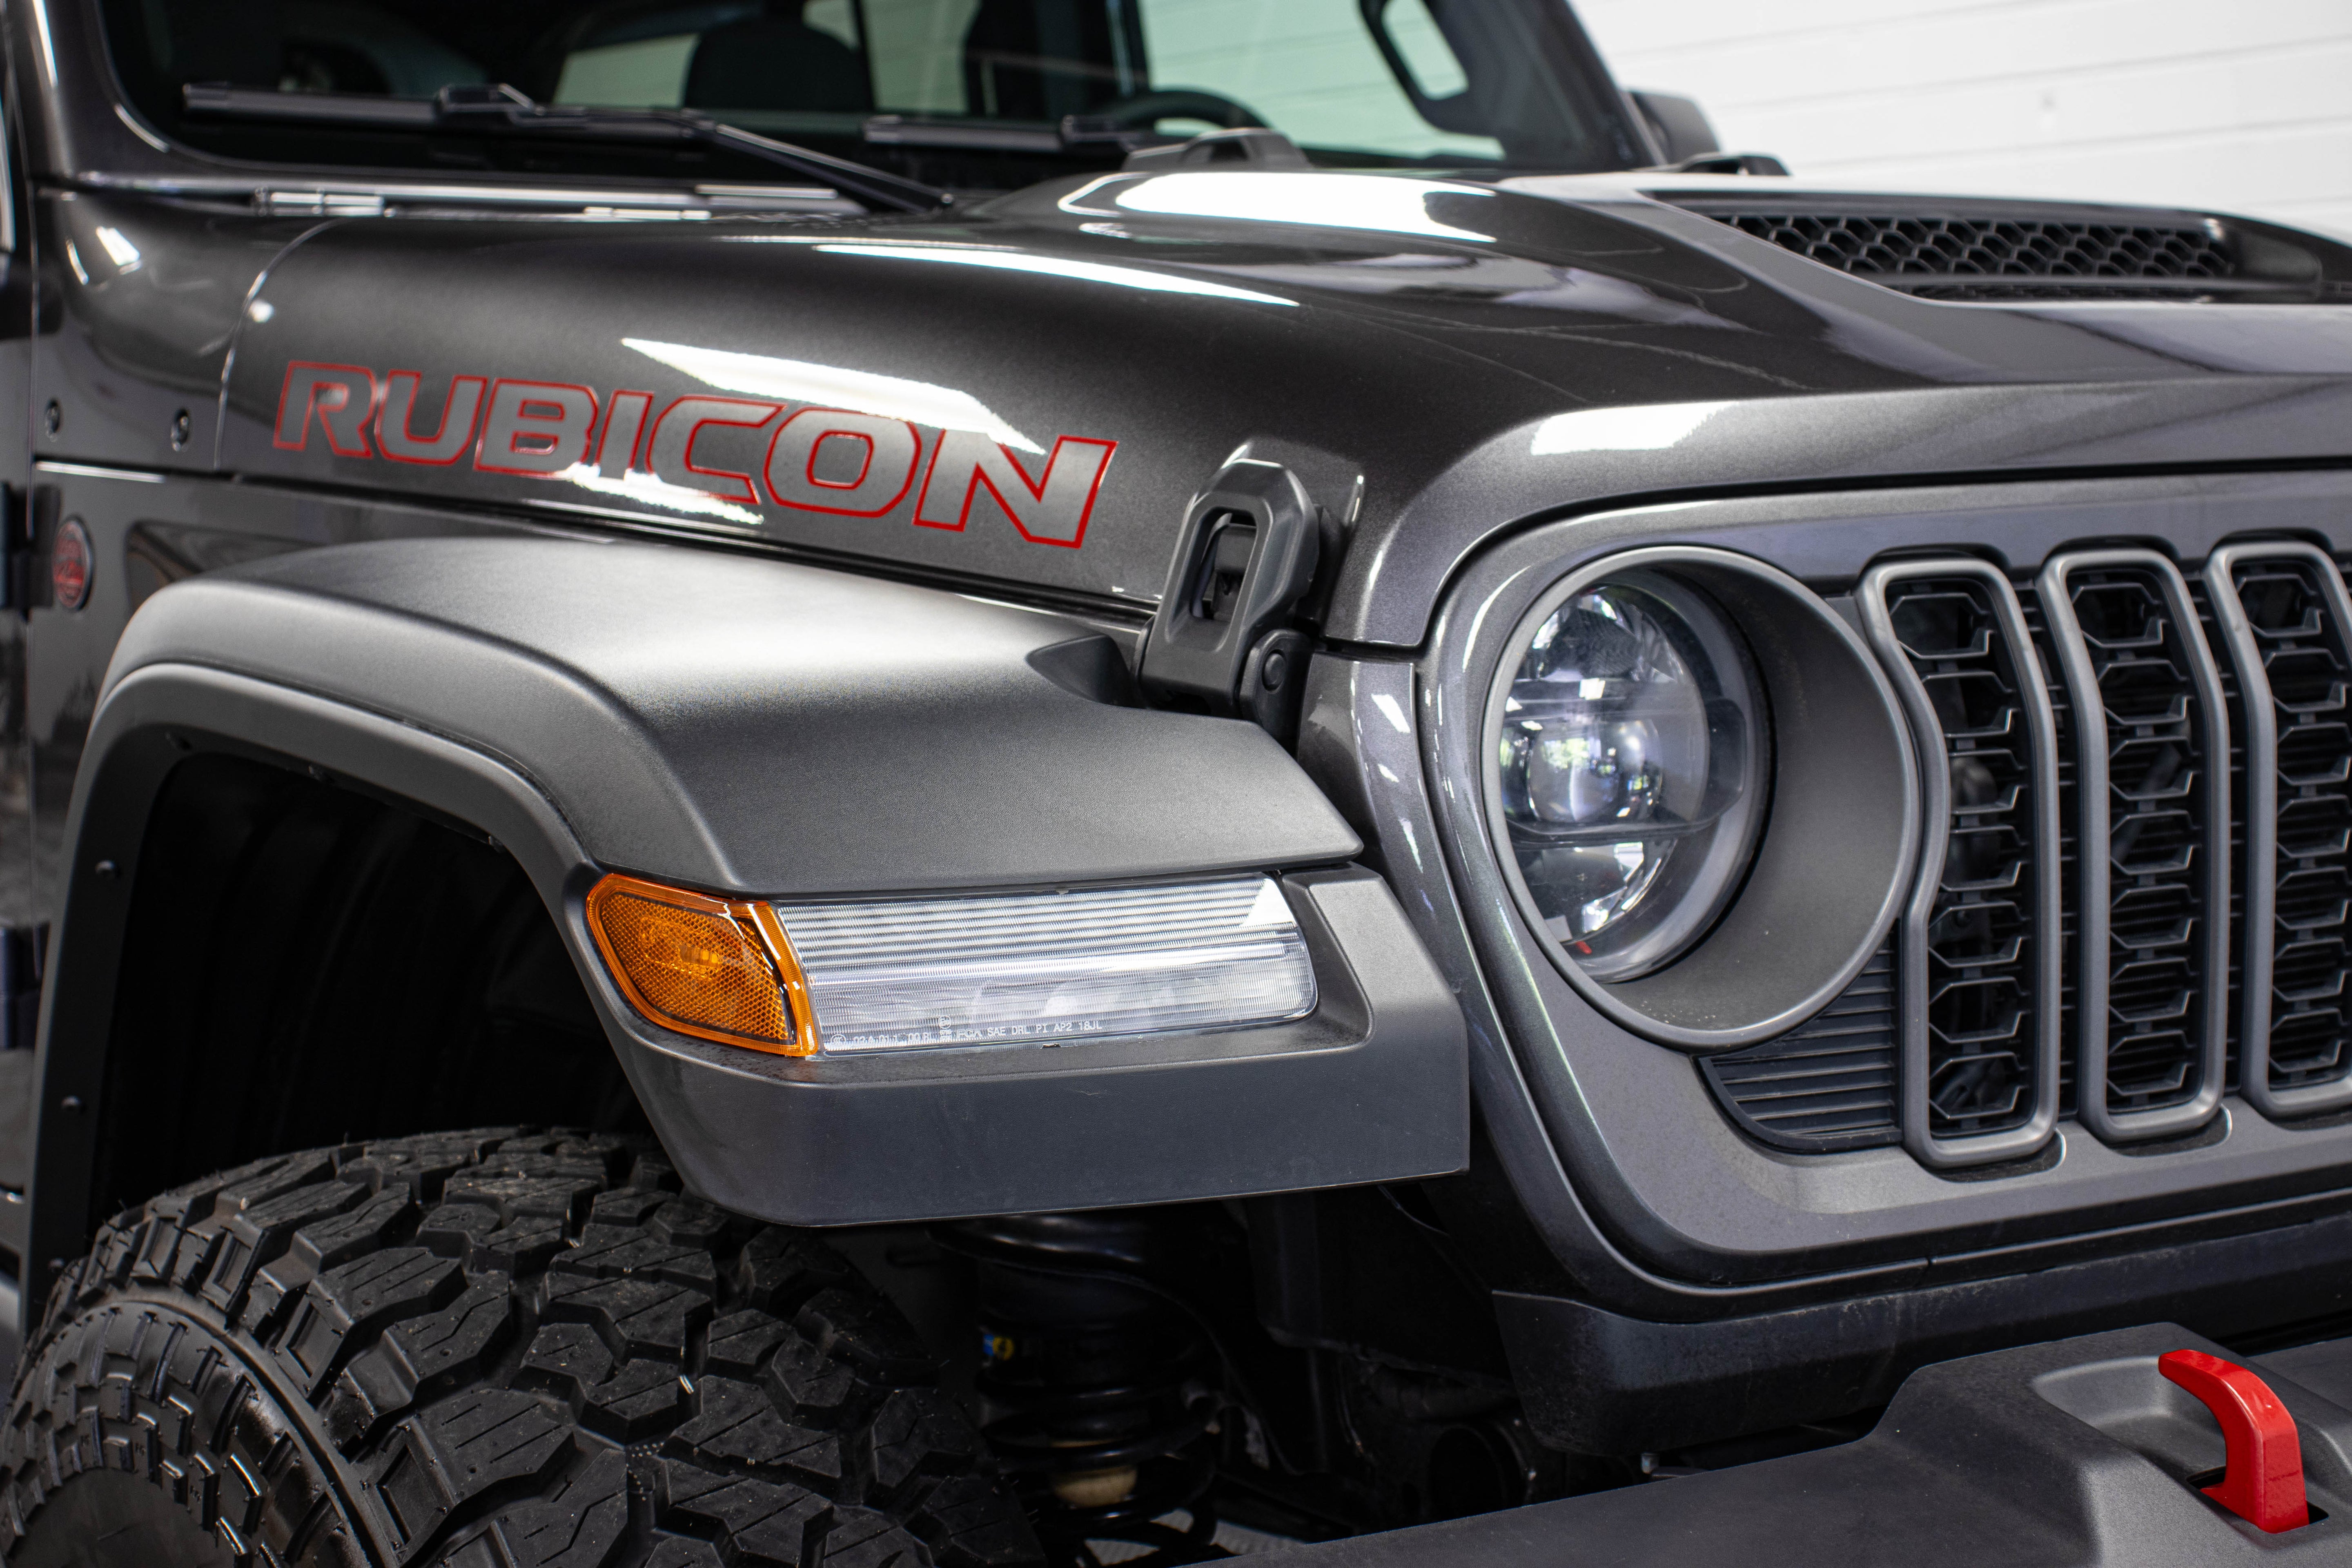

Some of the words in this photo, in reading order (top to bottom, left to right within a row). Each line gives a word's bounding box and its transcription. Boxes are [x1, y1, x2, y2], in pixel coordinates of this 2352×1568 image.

[272, 361, 1119, 548] RUBICON
[987, 1026, 1006, 1036] SAE
[1011, 1025, 1031, 1035] DRL
[1053, 1022, 1072, 1032] AP2
